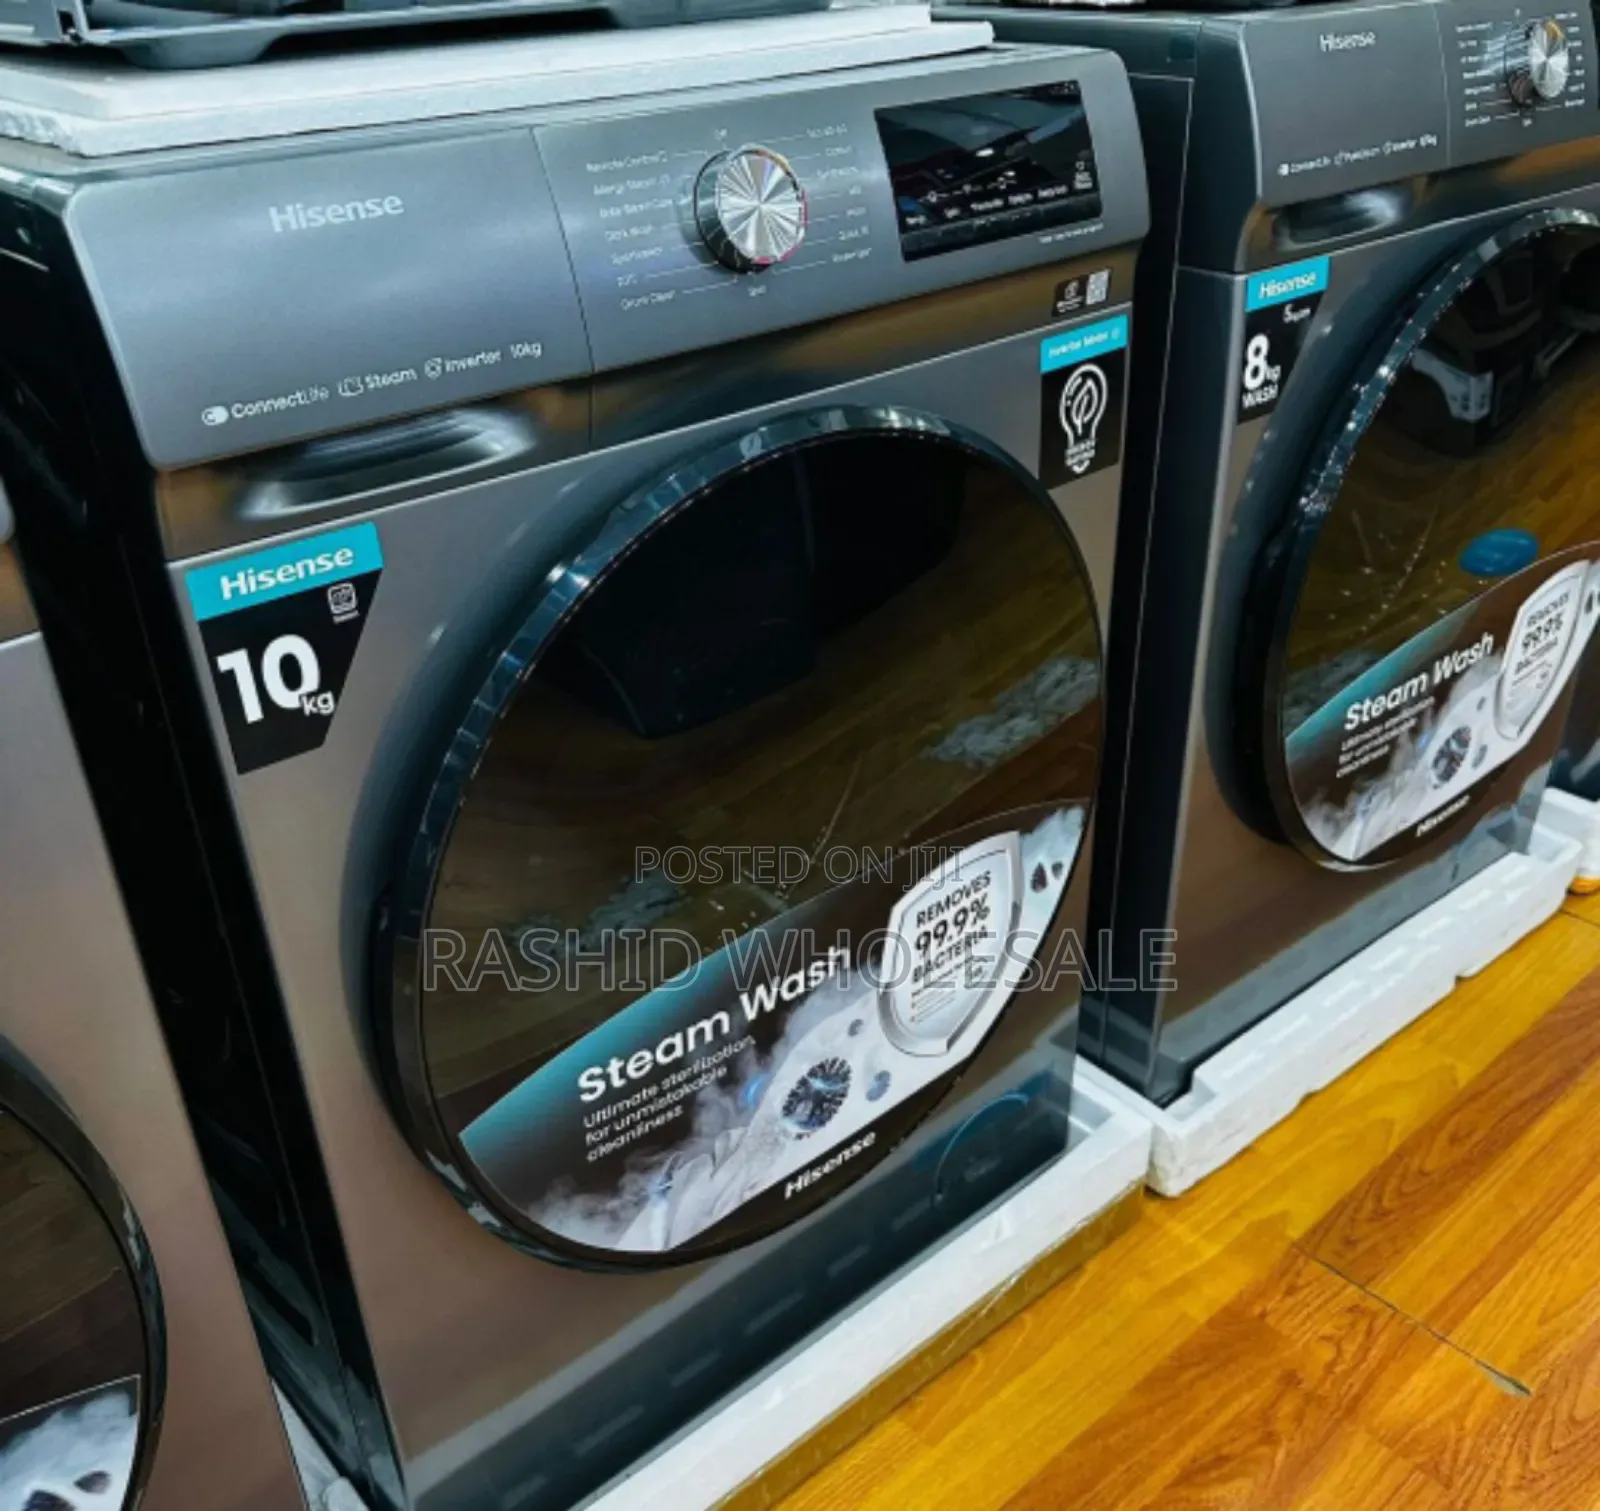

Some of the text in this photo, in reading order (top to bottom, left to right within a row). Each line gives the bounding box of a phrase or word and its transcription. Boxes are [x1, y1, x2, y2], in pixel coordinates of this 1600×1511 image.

[1320, 31, 1376, 53] Hisense
[268, 194, 404, 233] Hisense
[1259, 271, 1317, 299] Hisense
[366, 367, 418, 391] Steam
[445, 349, 502, 374] Inverter
[219, 547, 354, 601] Hisense
[1344, 671, 1429, 730] Steam
[1432, 631, 1495, 684] Wash
[915, 892, 991, 958] 99.9%
[916, 869, 992, 928] REMOVES
[911, 924, 989, 984] BACTERIA
[577, 1010, 731, 1102] Steam
[738, 945, 851, 1022] Wash
[583, 1084, 660, 1129] Ultimate
[586, 1123, 612, 1146] for
[784, 1131, 877, 1200] Hisense
